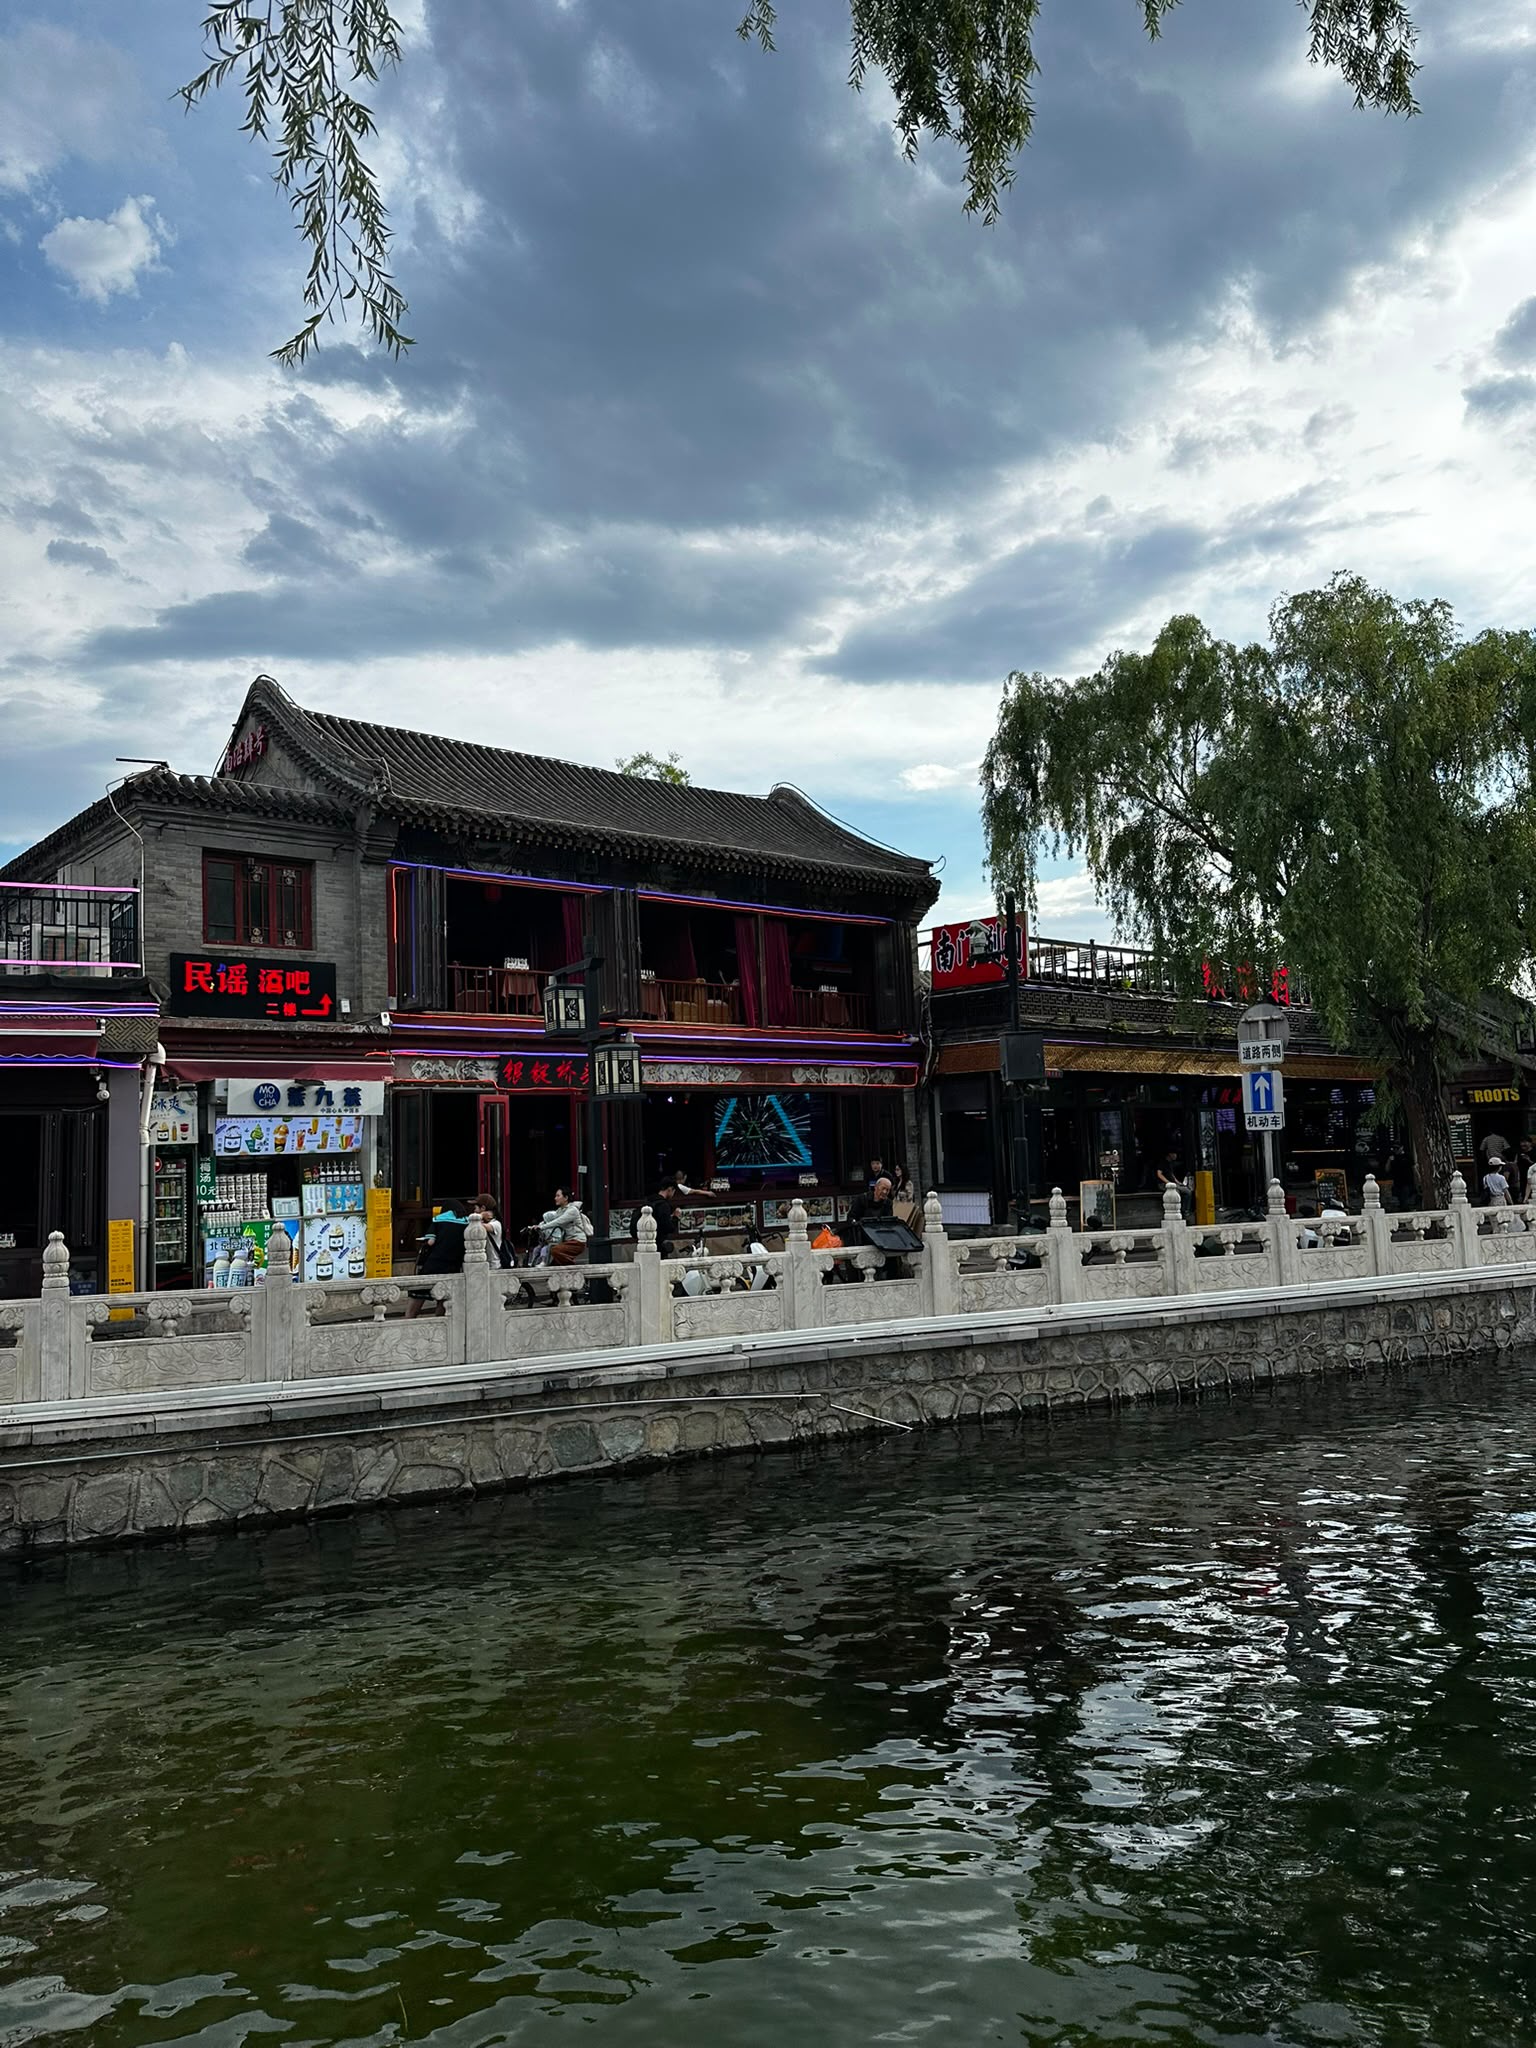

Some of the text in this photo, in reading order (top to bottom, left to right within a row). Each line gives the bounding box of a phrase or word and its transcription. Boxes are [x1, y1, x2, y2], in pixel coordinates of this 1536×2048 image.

[184, 960, 311, 996] 民谣 酒吧
[266, 1002, 297, 1017] 二楼
[1242, 1044, 1282, 1060] 道路两侧
[259, 1085, 275, 1094] MO
[1473, 1087, 1520, 1103] ROOTS
[151, 1096, 186, 1115] 冰爽
[258, 1098, 277, 1107] CHA
[1247, 1115, 1281, 1128] 机动车
[196, 1184, 217, 1196] 10元
